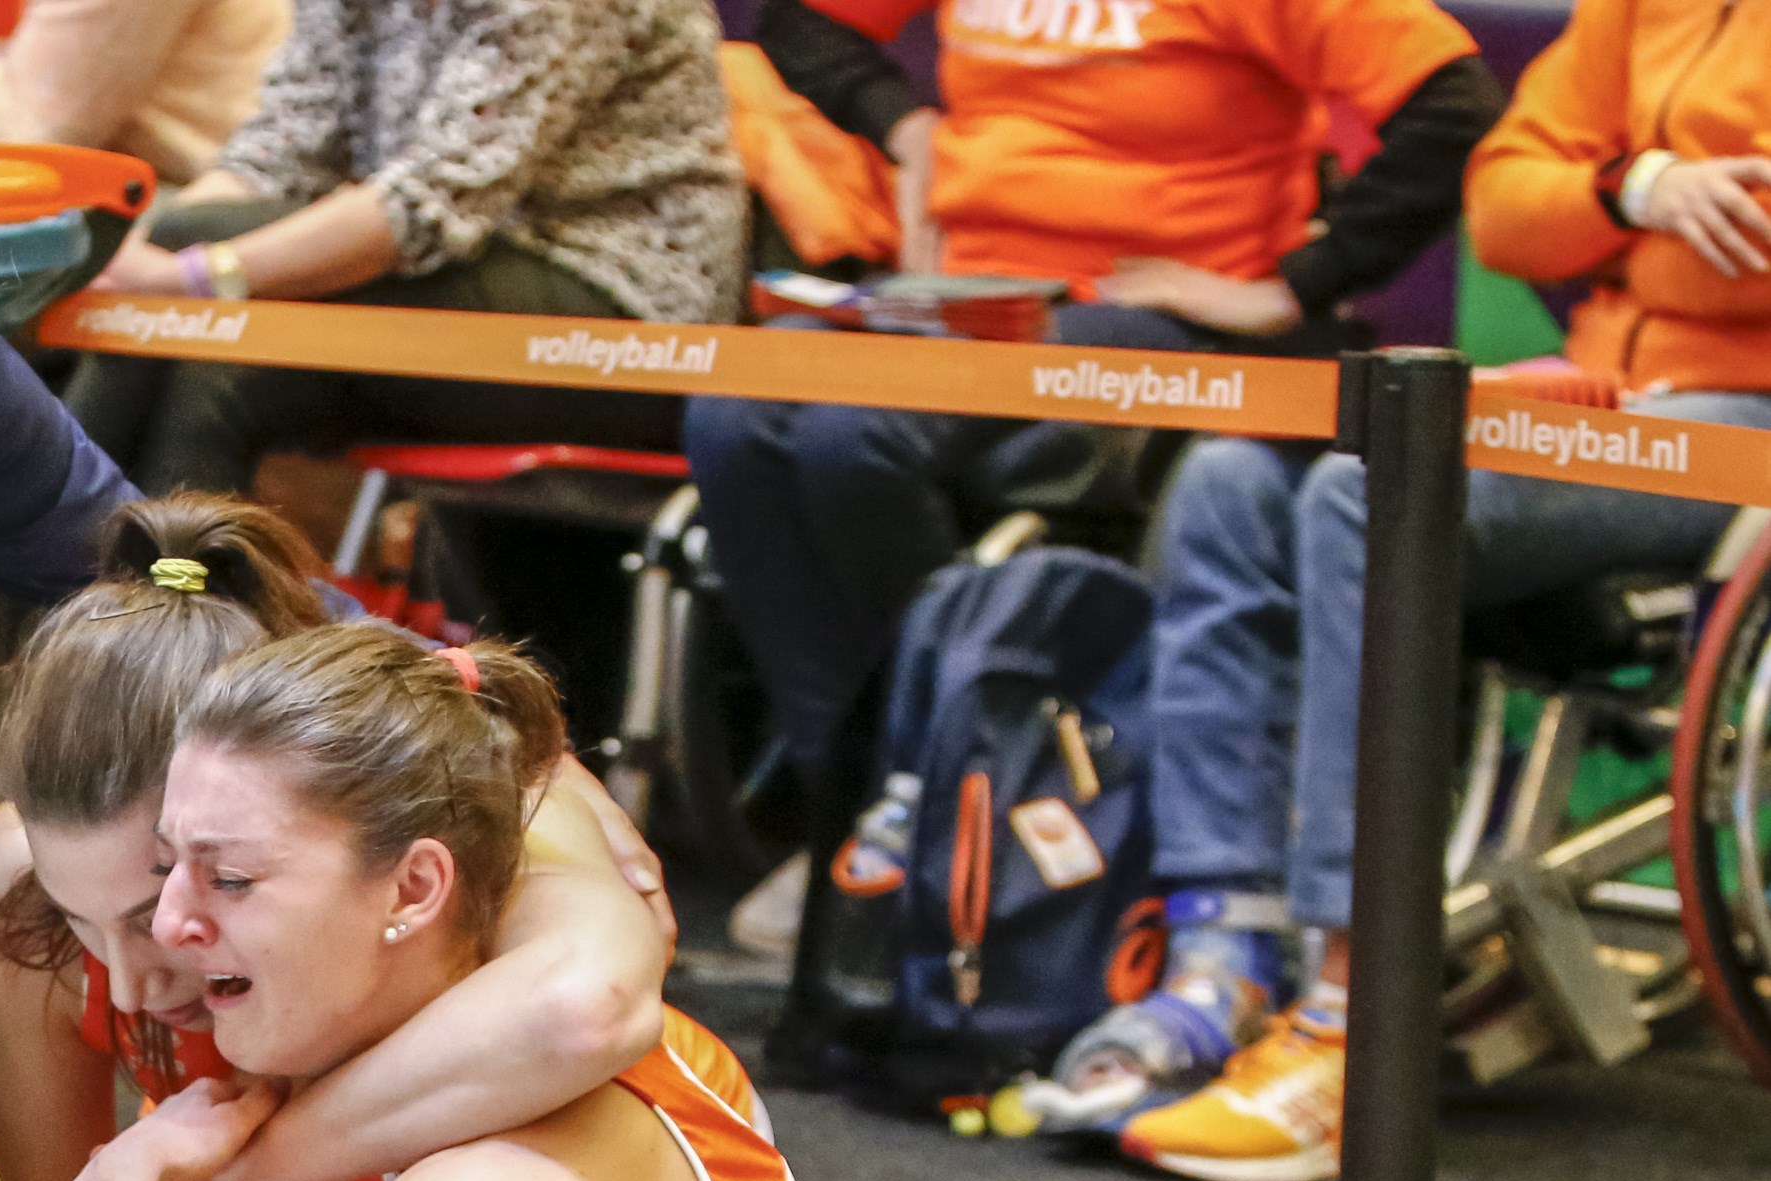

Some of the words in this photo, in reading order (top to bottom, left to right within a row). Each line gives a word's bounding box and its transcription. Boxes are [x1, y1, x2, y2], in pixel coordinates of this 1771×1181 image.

[528, 329, 719, 376] volleybal.nl
[1033, 359, 1243, 411] volleybal.nl
[1465, 409, 1689, 473] volleybal.nl
